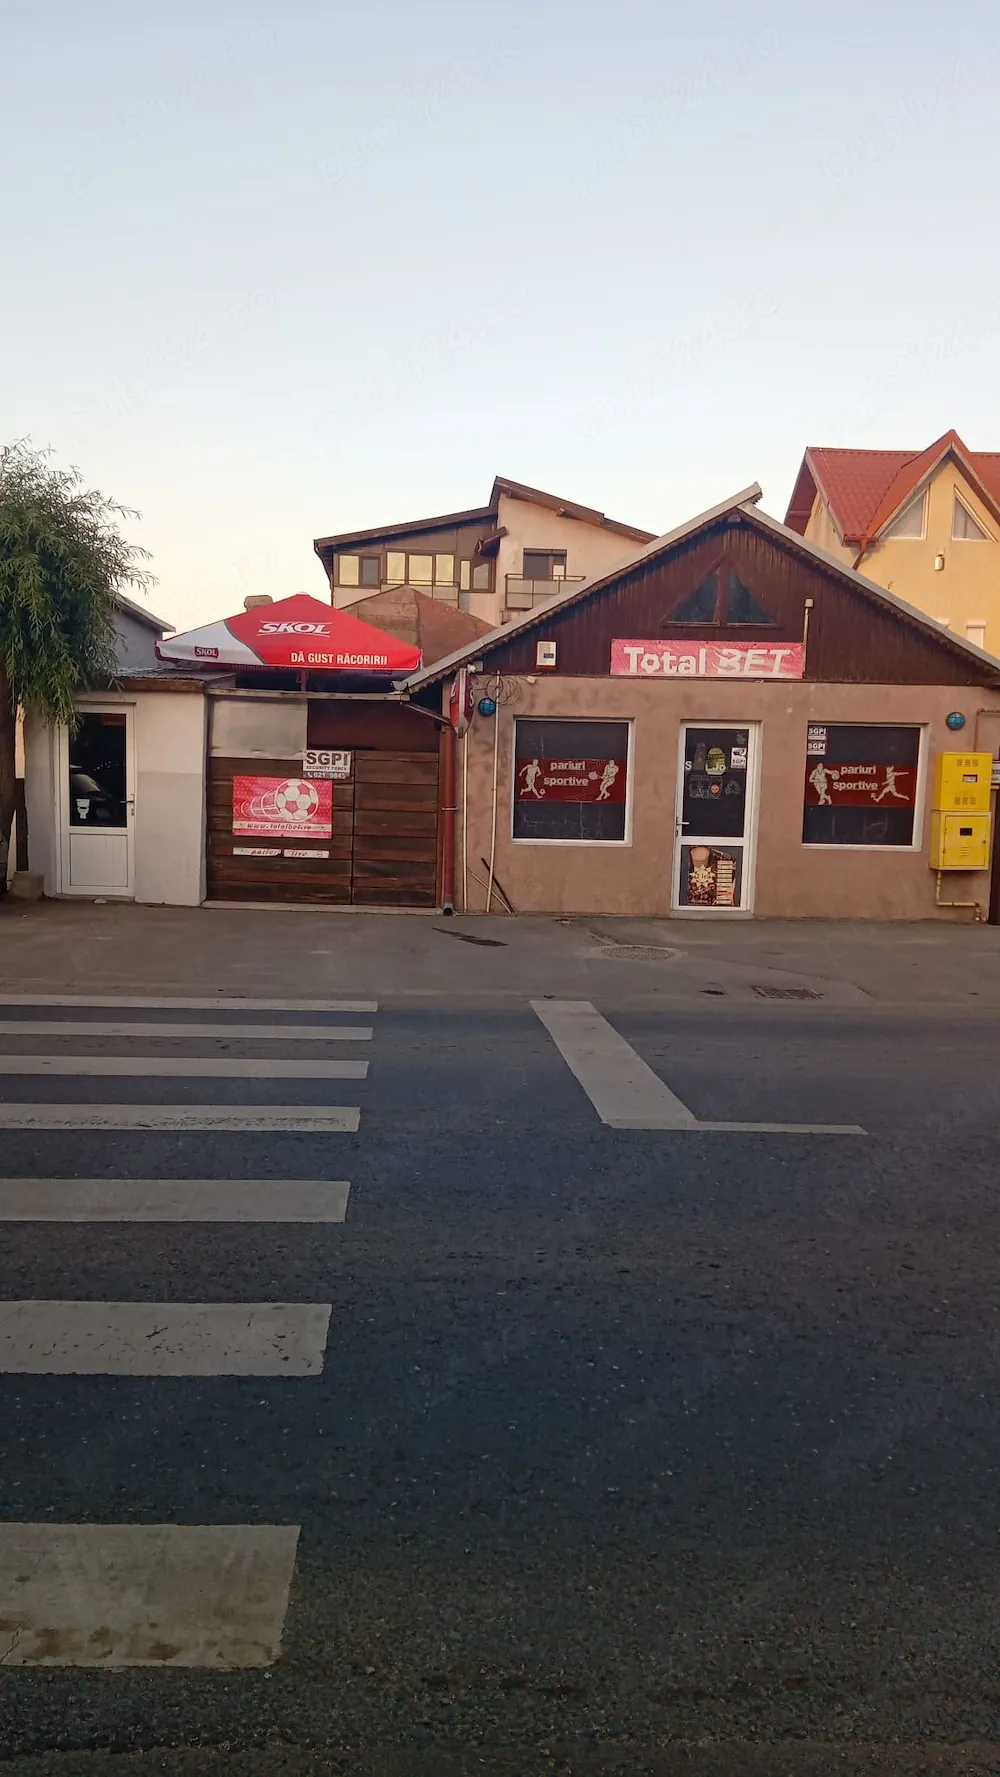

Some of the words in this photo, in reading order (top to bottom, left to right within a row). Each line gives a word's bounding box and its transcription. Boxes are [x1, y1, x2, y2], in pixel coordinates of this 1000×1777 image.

[257, 621, 331, 635] SKOL
[196, 647, 217, 656] SKOL
[291, 651, 306, 662] DĂ
[308, 653, 334, 664] GUST
[337, 652, 388, 666] RĂCORIRII
[623, 646, 706, 675] Total
[713, 648, 792, 676] BET
[307, 752, 347, 766] SGPI
[550, 761, 586, 772] pariuri
[840, 765, 877, 776] pariuri
[543, 777, 589, 787] sportive
[833, 781, 879, 792] sportive
